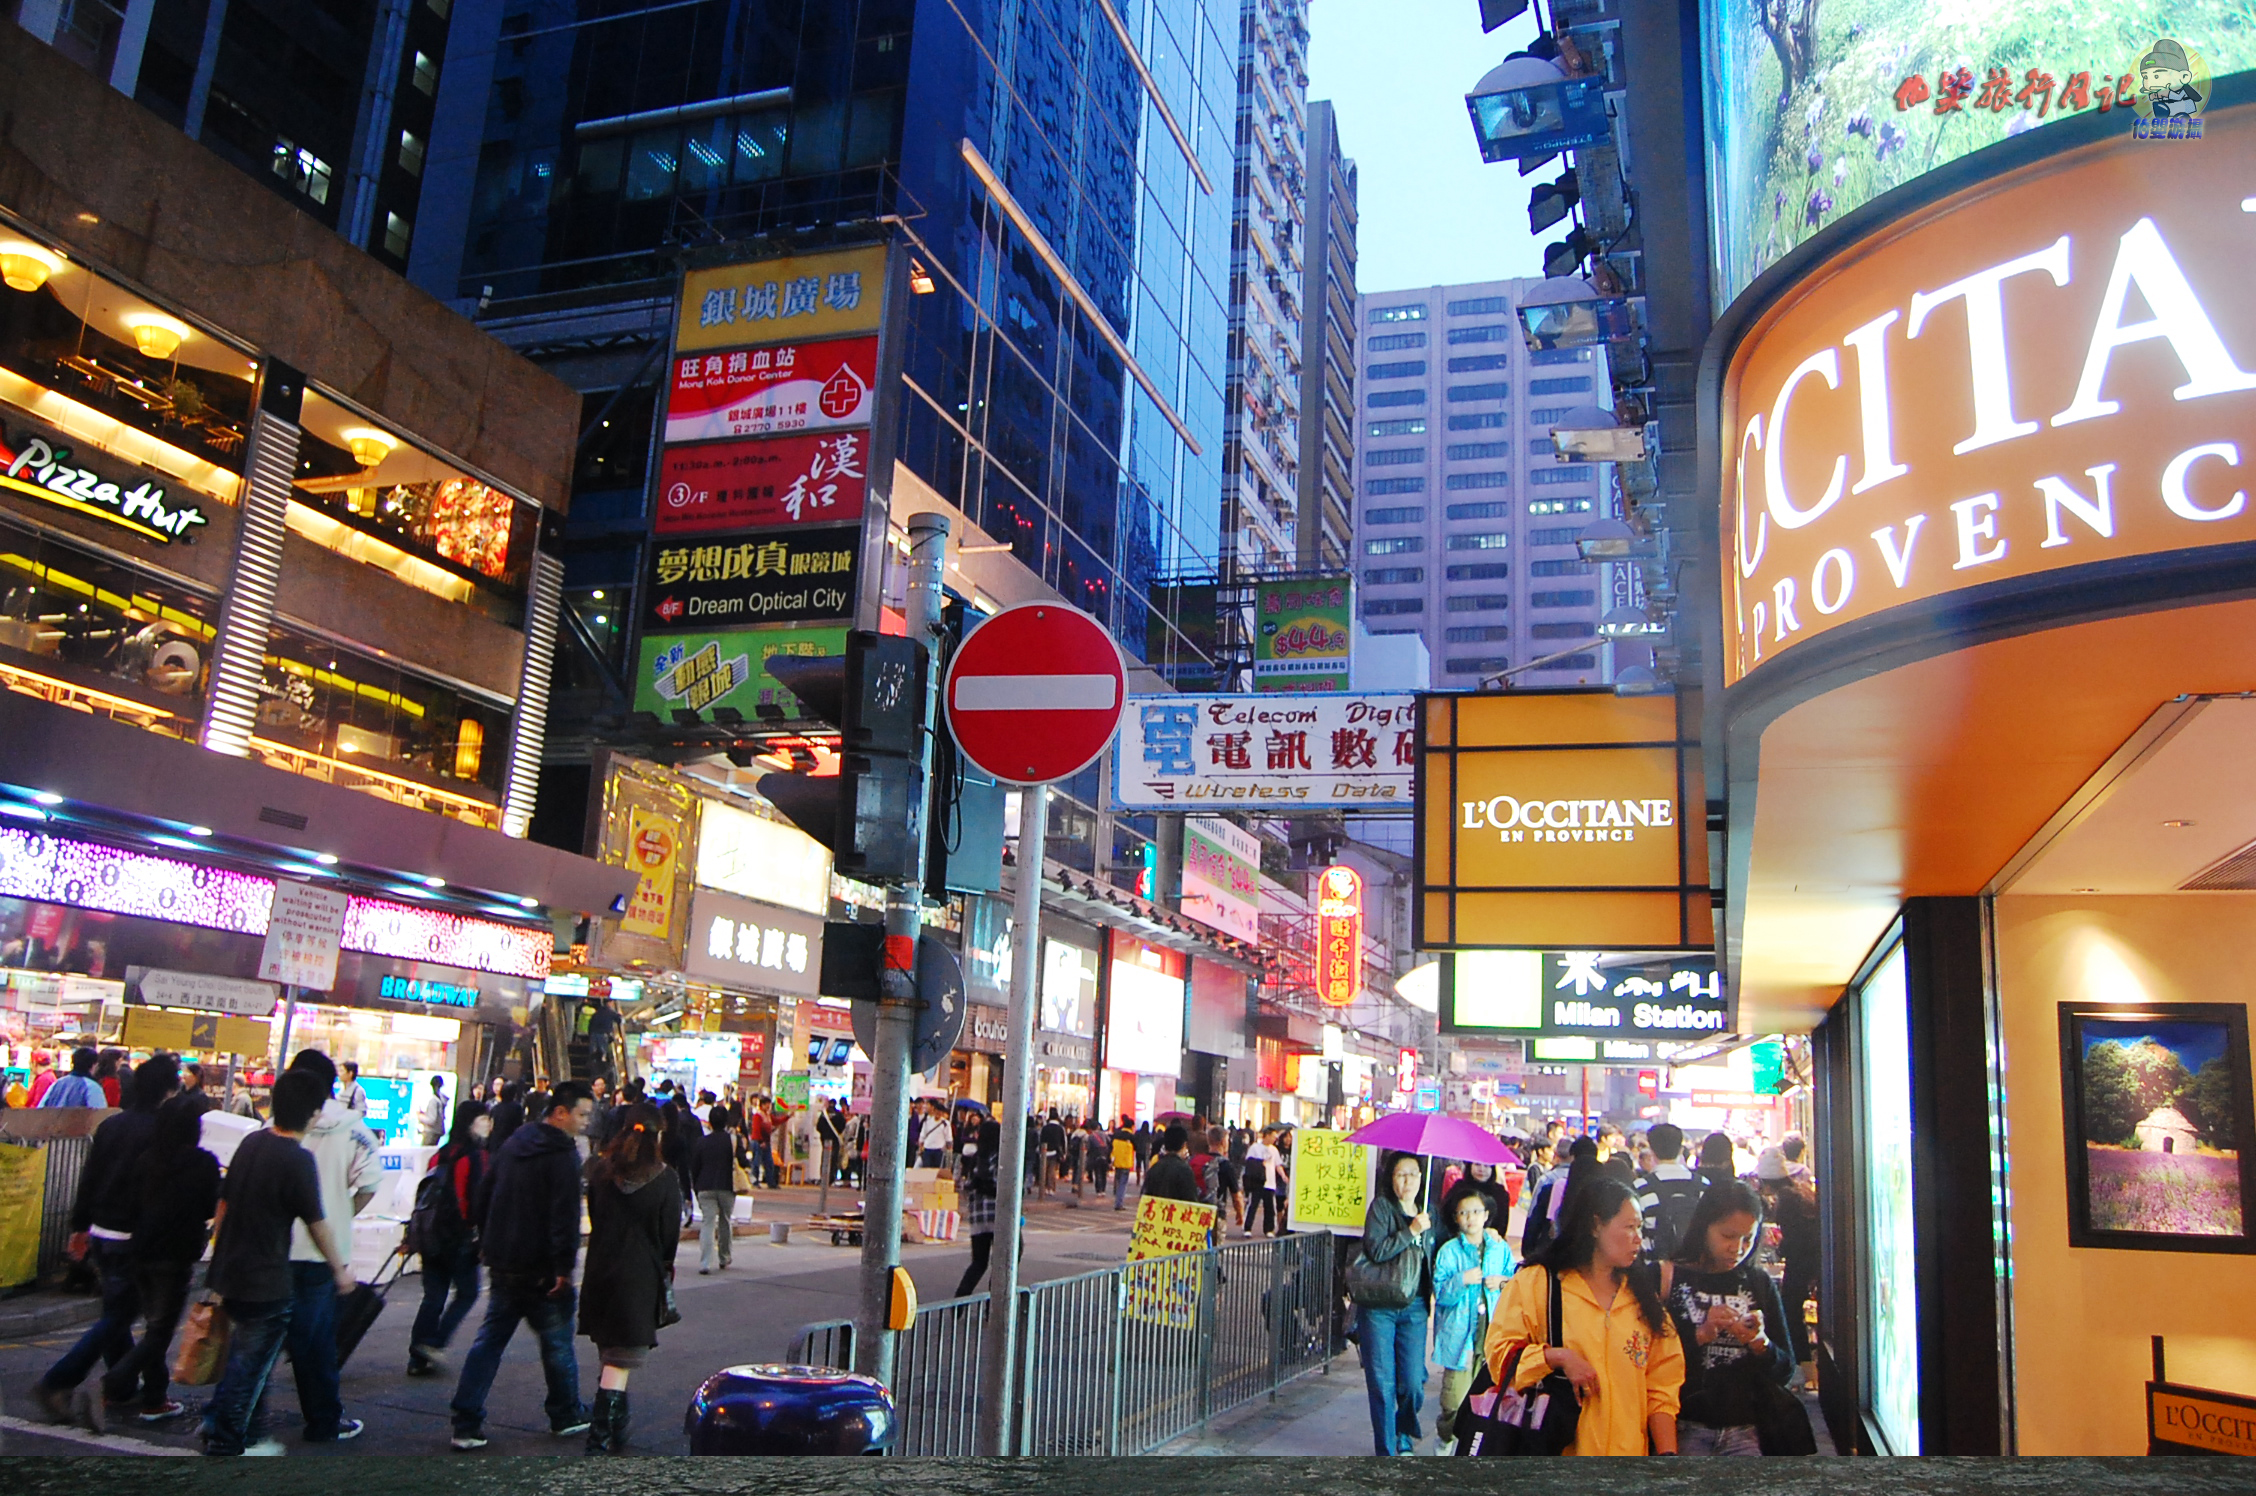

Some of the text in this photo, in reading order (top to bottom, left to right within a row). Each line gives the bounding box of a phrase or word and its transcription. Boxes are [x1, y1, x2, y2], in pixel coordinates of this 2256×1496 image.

[700, 271, 862, 327] 銀城廣場
[680, 347, 796, 378] 旺角捐血站
[678, 369, 793, 390] Mong Kok Donor Center
[744, 421, 771, 432] 2770
[8, 438, 206, 536] Pizza Hut
[688, 596, 743, 617] Dream
[749, 591, 807, 616] Optical
[812, 588, 847, 613] City
[1208, 702, 1318, 726] Telecom
[1185, 782, 1397, 799] Wireless Data
[1462, 795, 1674, 829] L'OCCITANE
[1500, 829, 1635, 842] EN PROVENCE
[298, 886, 328, 901] Vehicle
[282, 896, 339, 915] waiting will be
[286, 907, 332, 924] prosecuted
[274, 916, 340, 937] without warning
[380, 975, 480, 1008] BROADWAY
[1554, 1001, 1724, 1030] Milan Station
